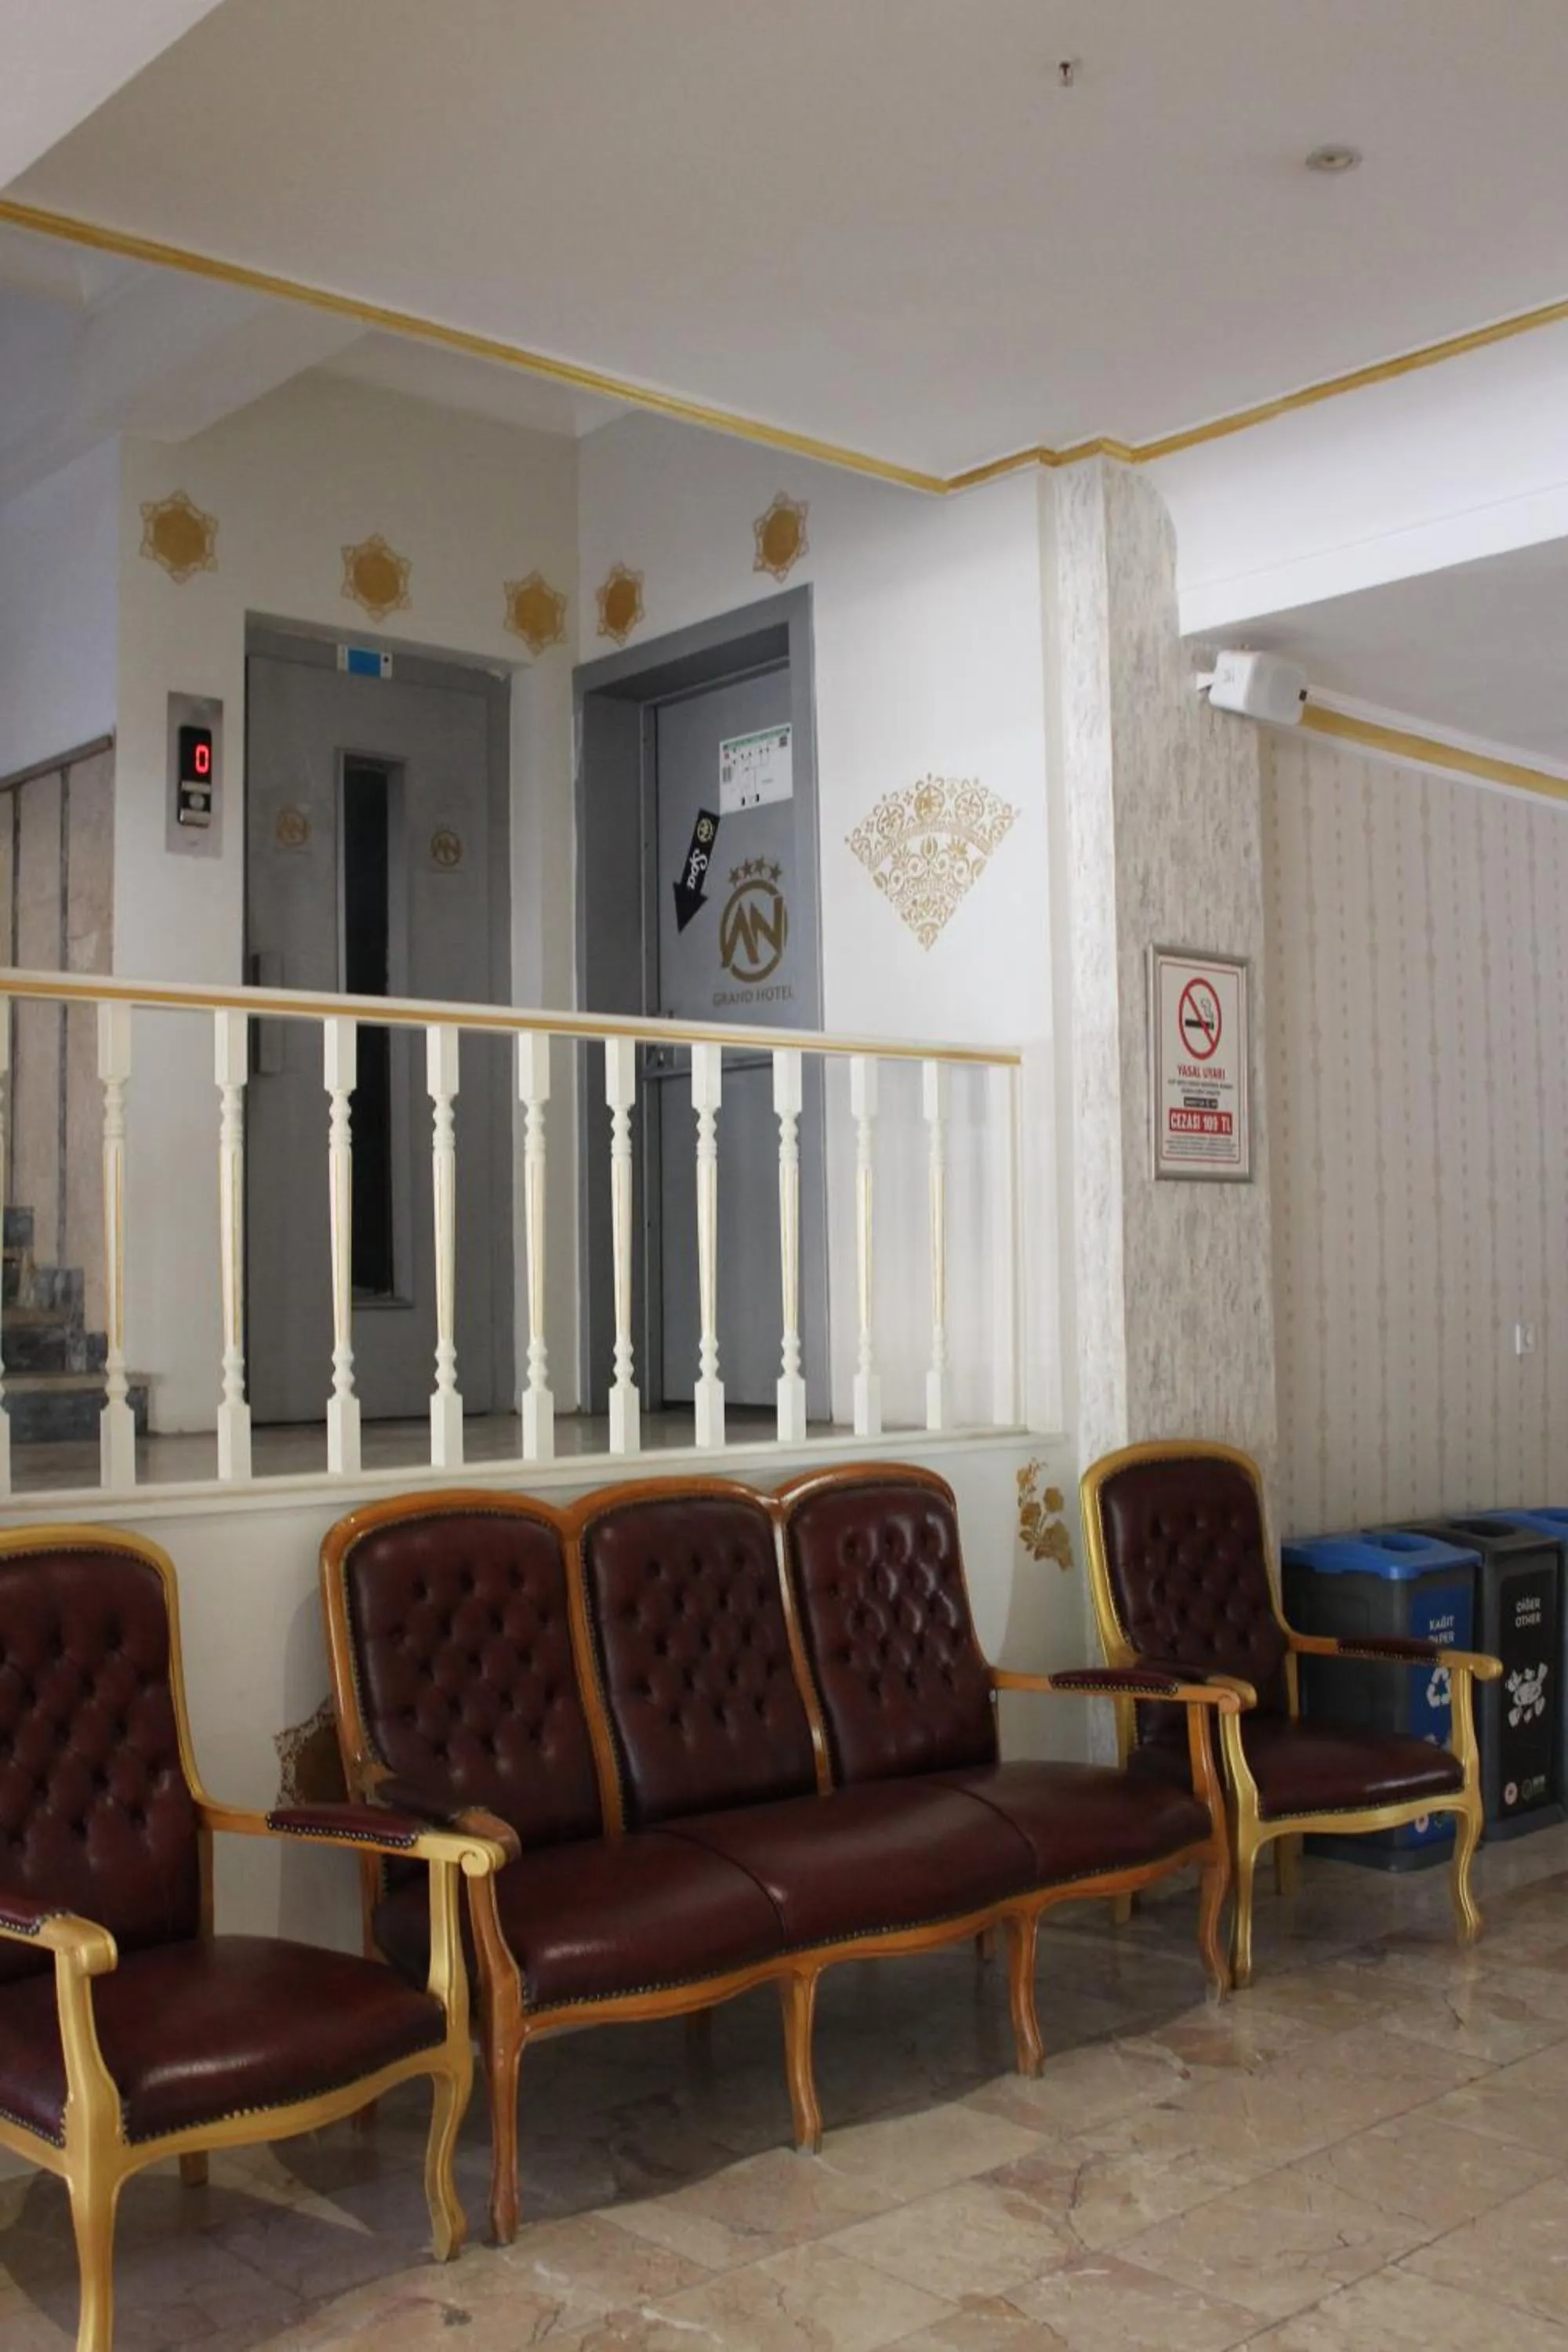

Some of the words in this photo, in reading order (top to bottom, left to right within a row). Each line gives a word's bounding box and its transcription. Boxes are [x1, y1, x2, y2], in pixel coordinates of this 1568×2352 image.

[687, 848, 708, 891] Spa
[712, 989, 753, 1008] GRAND
[756, 985, 795, 1001] HOTEL
[1178, 1064, 1201, 1079] YASAL
[1171, 1112, 1200, 1131] CEZASI
[1221, 1115, 1232, 1134] TL
[1515, 1612, 1541, 1628] OTHER
